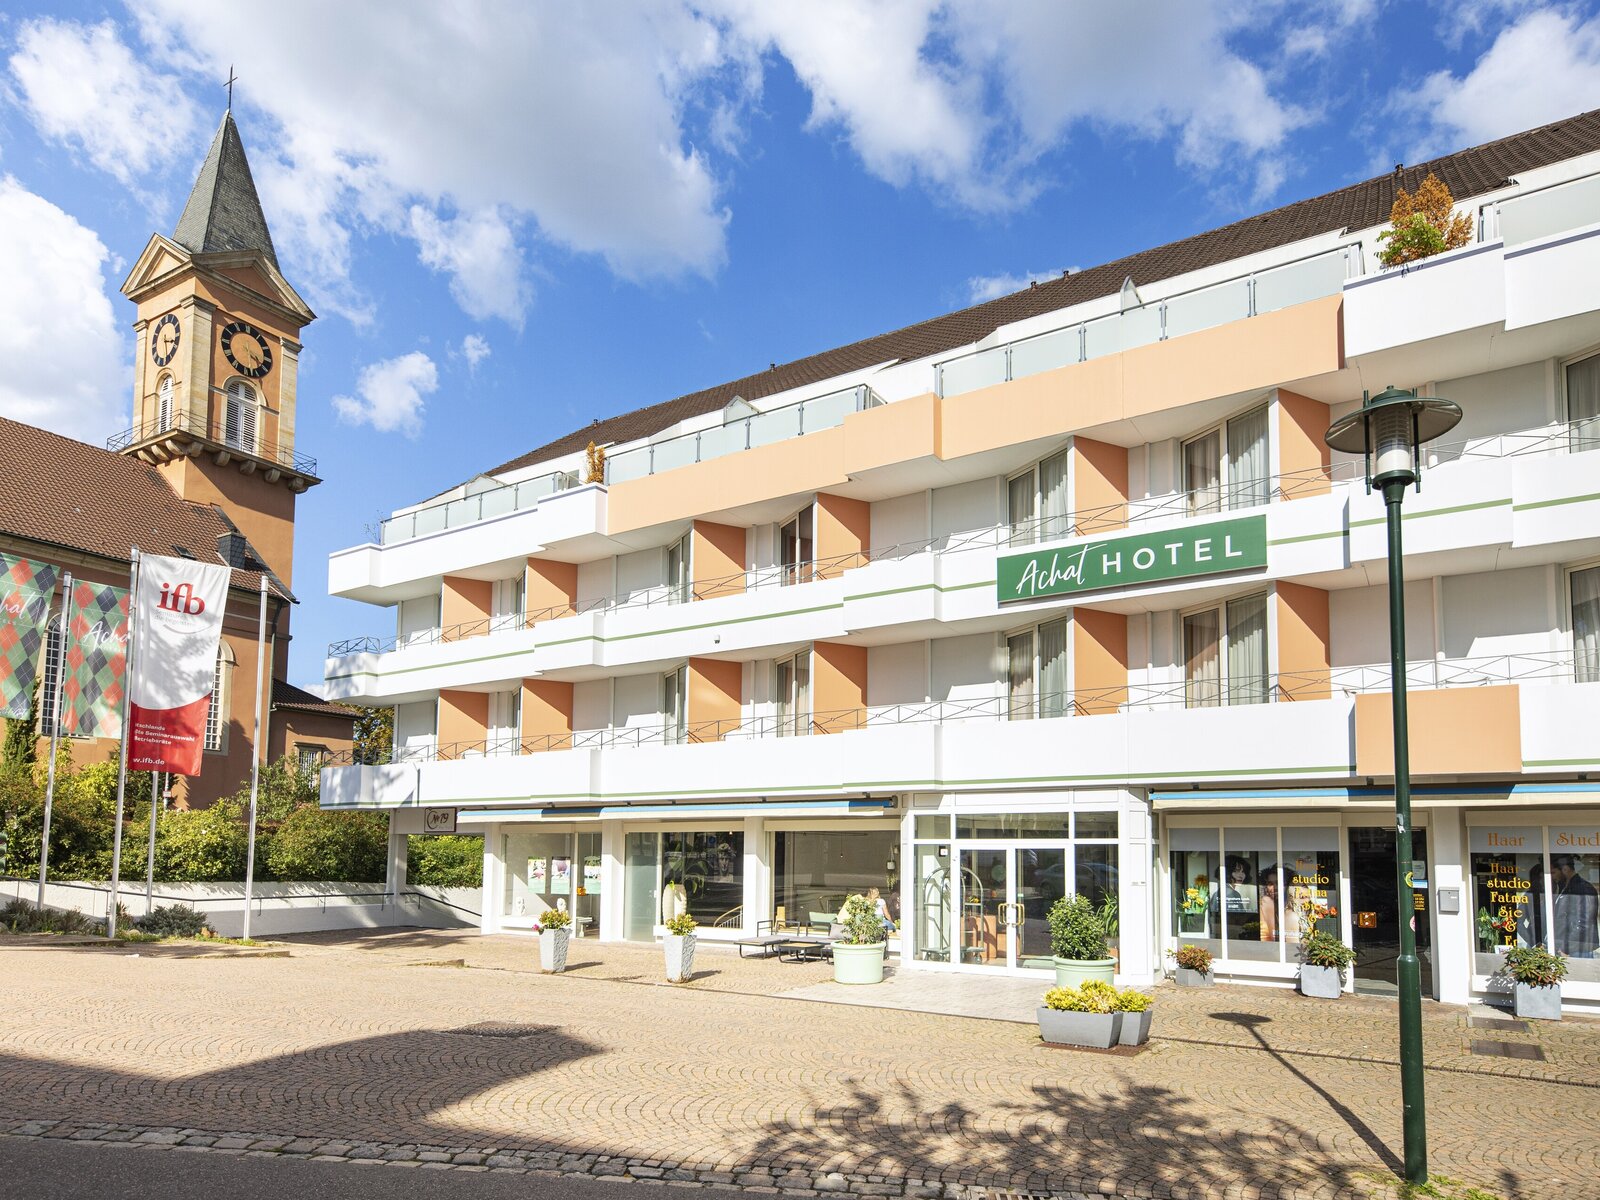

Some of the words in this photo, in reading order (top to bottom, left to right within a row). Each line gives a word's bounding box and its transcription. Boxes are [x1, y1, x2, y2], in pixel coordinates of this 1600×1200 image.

[1016, 543, 1107, 595] Achat
[1102, 535, 1243, 575] HOTEL
[156, 582, 206, 616] ifb
[1487, 832, 1526, 847] Haar
[1292, 873, 1330, 885] studio
[1487, 877, 1531, 889] studio
[1490, 891, 1529, 904] Fatma
[1499, 905, 1523, 918] Sie
